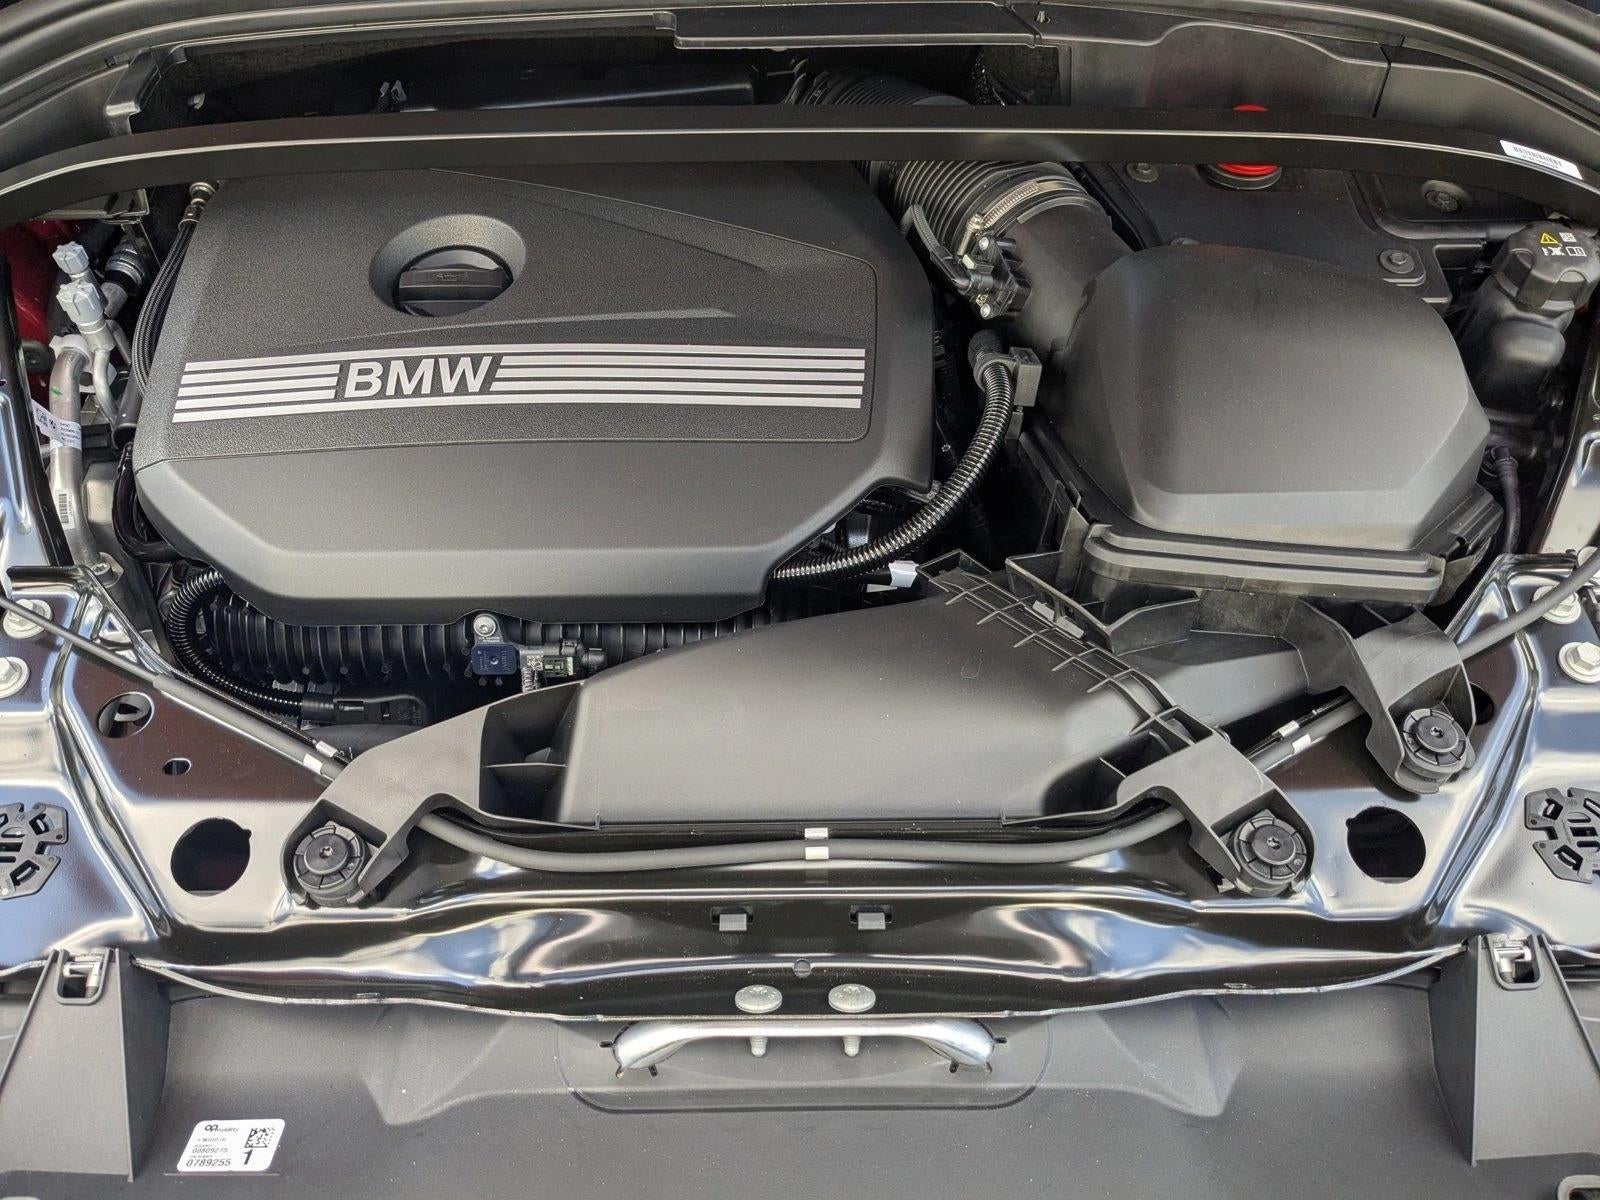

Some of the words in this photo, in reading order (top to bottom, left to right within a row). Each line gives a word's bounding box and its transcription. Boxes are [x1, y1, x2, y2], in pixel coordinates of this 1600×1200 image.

[344, 356, 493, 398] BMW
[186, 1158, 232, 1168] 0789255
[243, 1149, 254, 1165] 1
